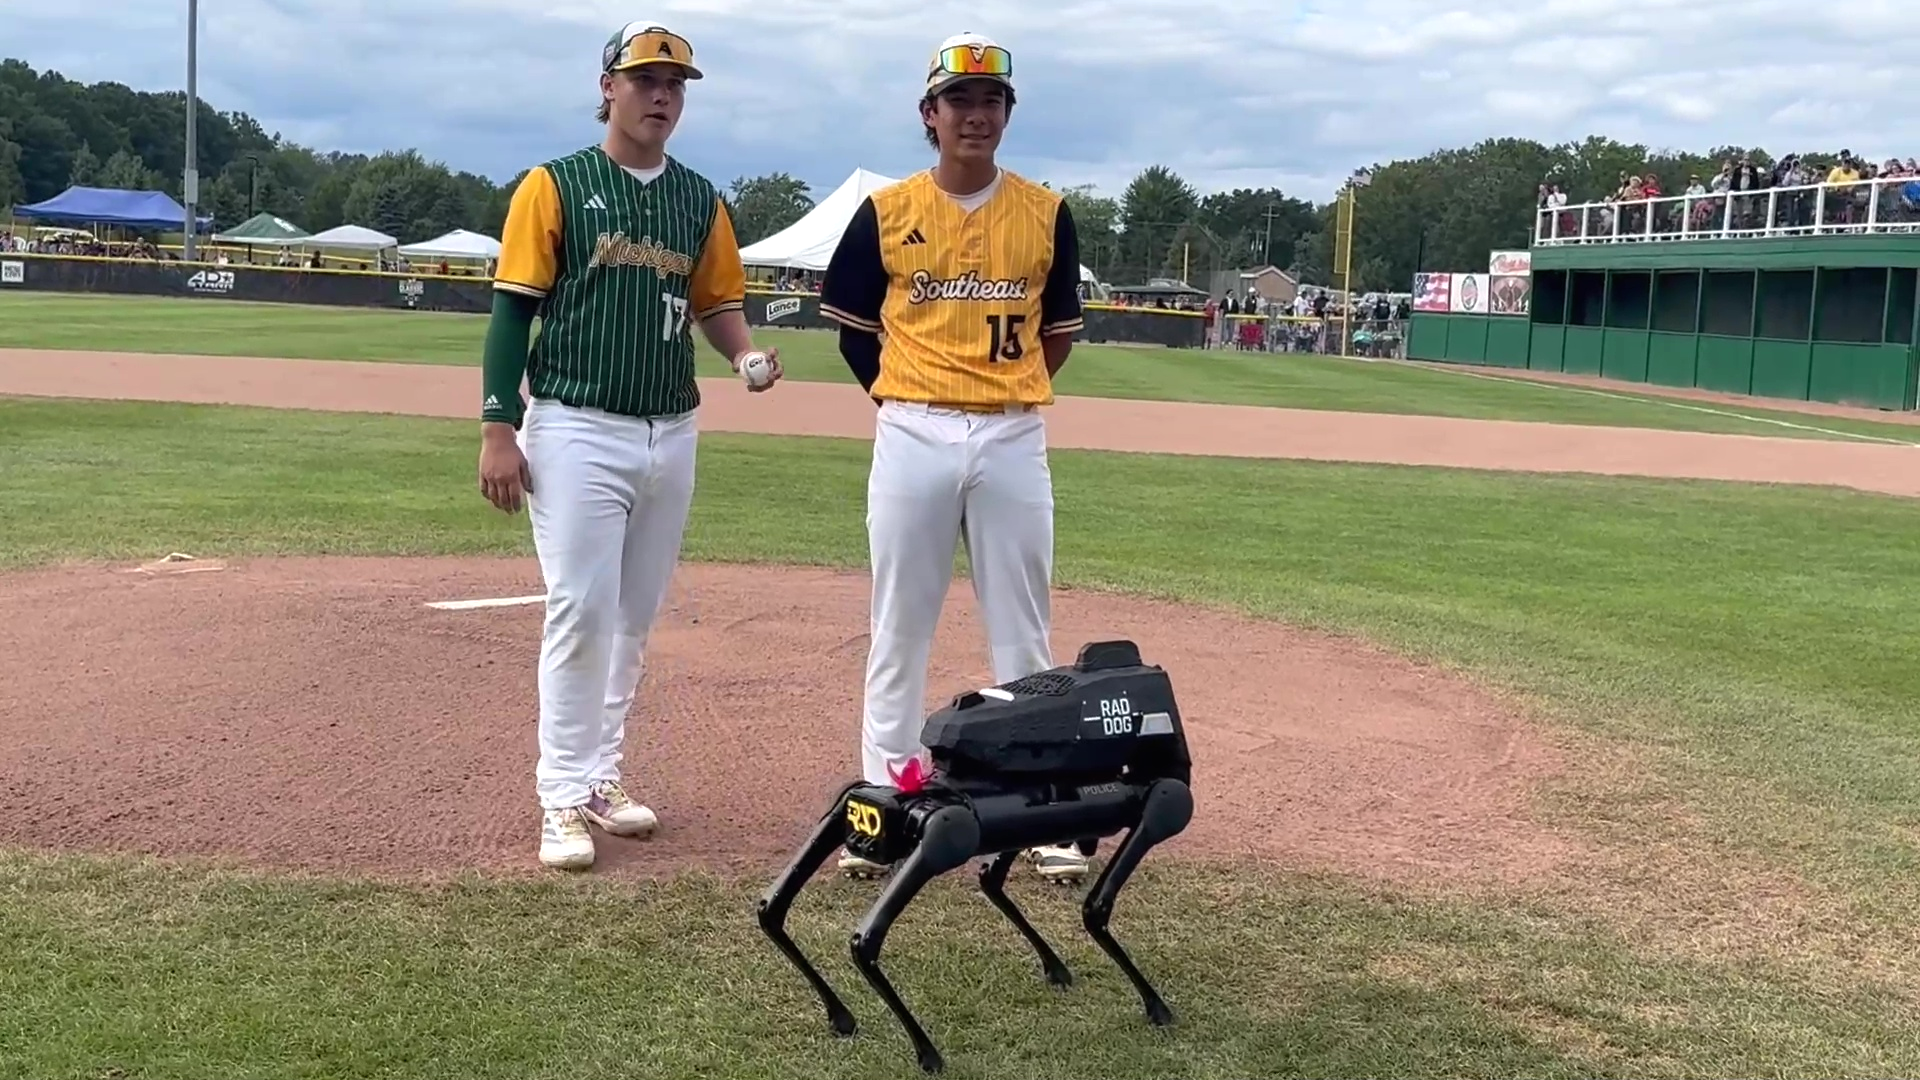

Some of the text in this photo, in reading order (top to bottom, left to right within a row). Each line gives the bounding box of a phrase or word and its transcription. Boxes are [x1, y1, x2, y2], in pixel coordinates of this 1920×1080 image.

[909, 269, 1028, 305] Southeast
[662, 292, 688, 343] 17
[769, 301, 798, 315] Lance
[986, 314, 1026, 363] 15
[1100, 698, 1131, 717] RAD
[1103, 716, 1132, 735] DOG
[1083, 783, 1119, 796] POLICE
